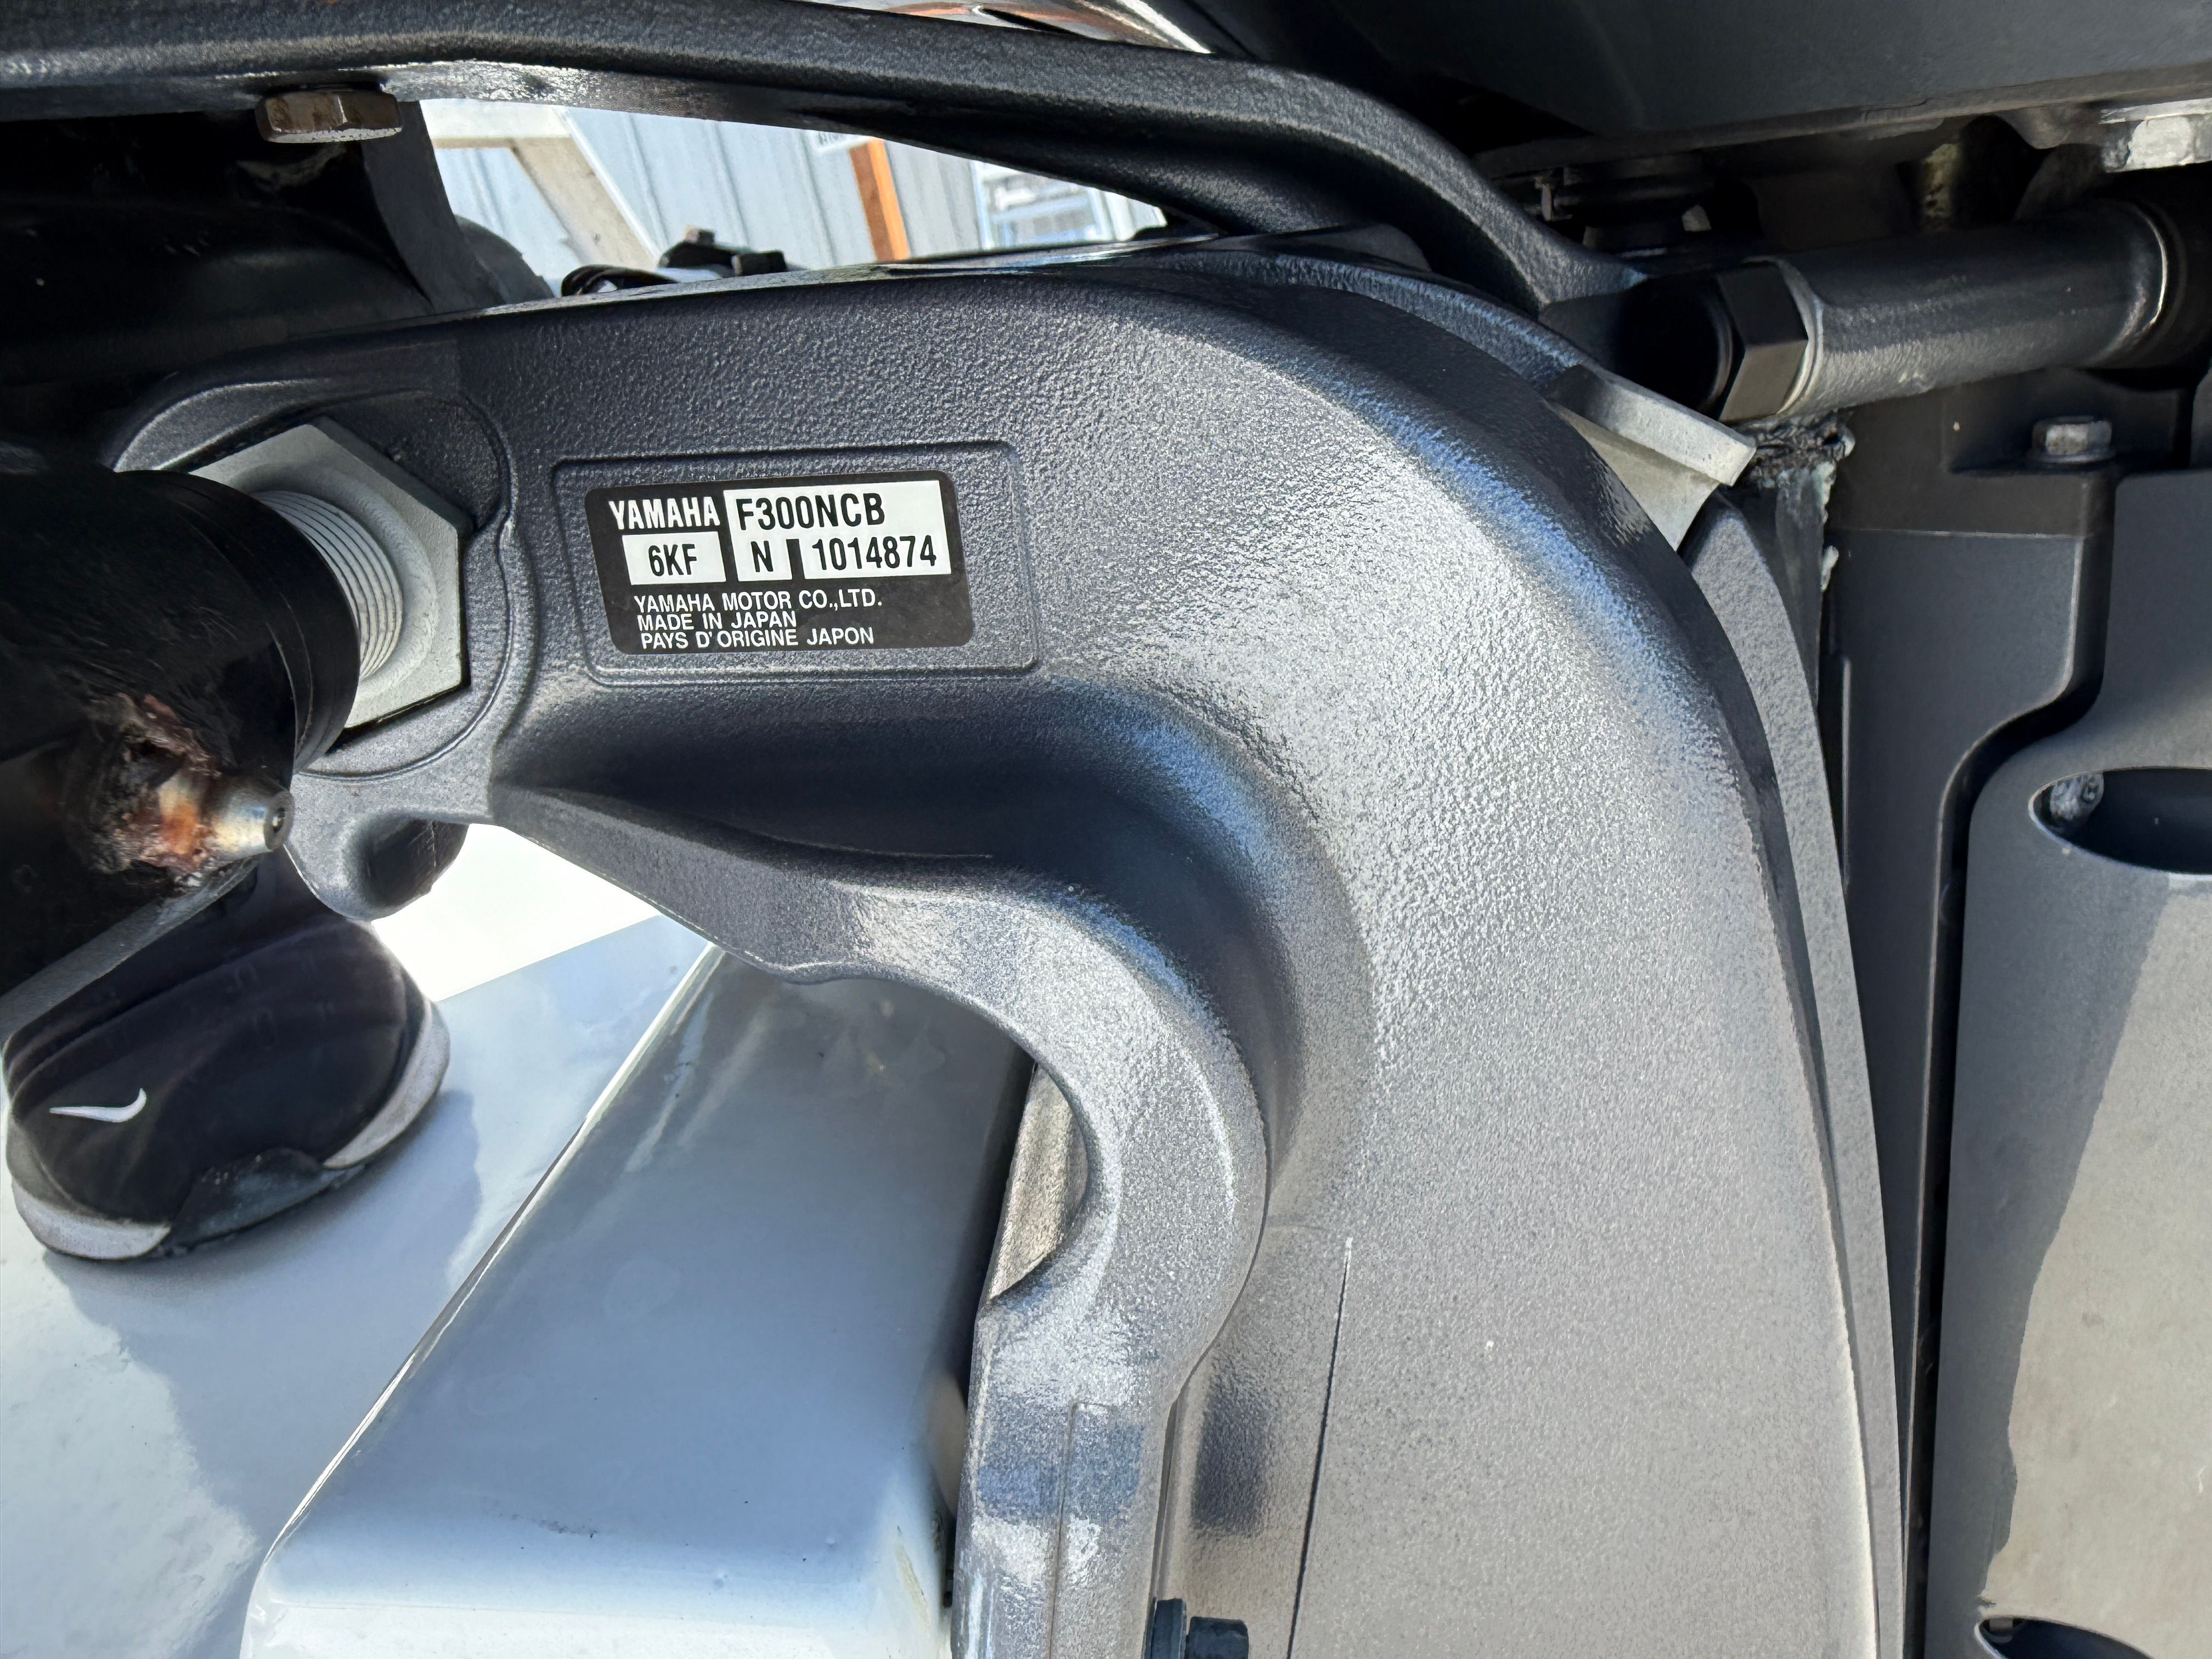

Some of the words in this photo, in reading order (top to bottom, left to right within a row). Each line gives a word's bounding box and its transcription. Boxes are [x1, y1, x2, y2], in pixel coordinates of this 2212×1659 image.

[608, 496, 720, 529] YAMAHA
[736, 493, 885, 531] F300NCB
[649, 544, 697, 578] 6KF
[752, 540, 773, 572] N
[812, 535, 936, 571] 1014874
[634, 594, 714, 613] YAMAHA
[723, 591, 791, 610] MOTOR
[637, 614, 695, 631] MADE
[703, 613, 723, 629] IN
[731, 611, 797, 629] JAPAN
[641, 632, 688, 649] PAYS
[807, 627, 874, 646] JAPON
